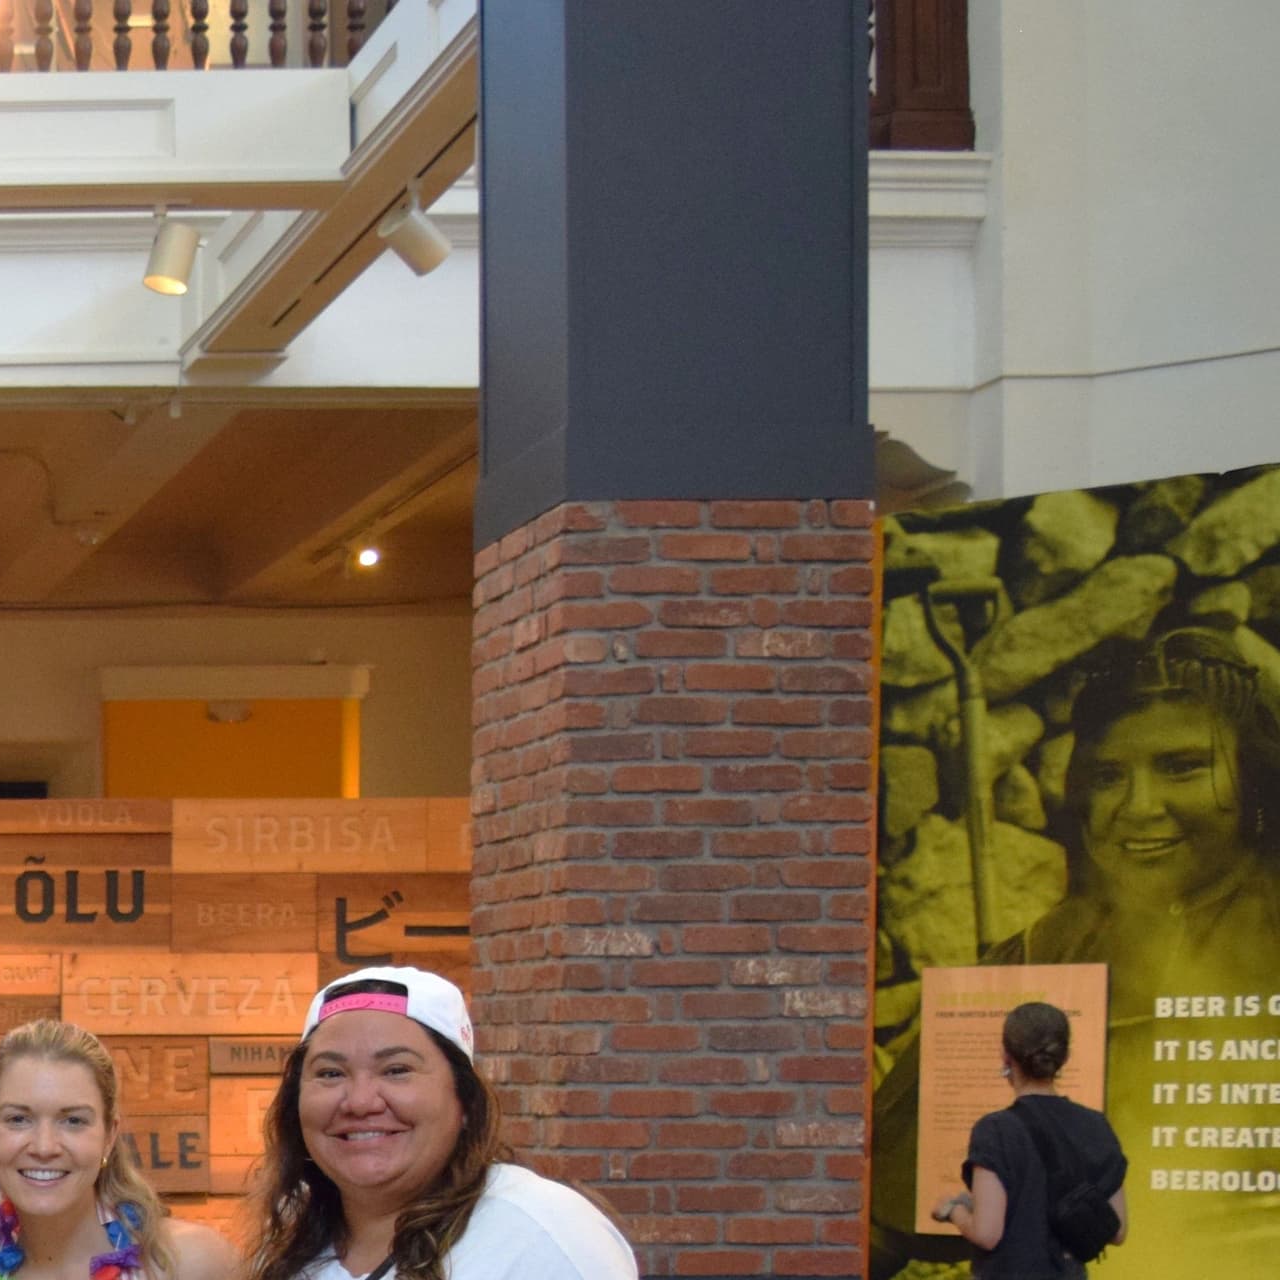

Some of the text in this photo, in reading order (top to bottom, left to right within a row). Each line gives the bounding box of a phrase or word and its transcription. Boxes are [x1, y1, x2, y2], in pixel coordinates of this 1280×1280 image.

[204, 815, 397, 852] SIRBISA
[15, 856, 145, 923] ÕLU
[81, 977, 296, 1016] CERVEZA
[1155, 997, 1225, 1018] BEER
[1234, 995, 1260, 1016] IS
[1154, 1040, 1180, 1061] IT
[1187, 1039, 1213, 1060] IS
[1153, 1084, 1179, 1104] IT
[1186, 1083, 1212, 1104] IS
[1152, 1127, 1177, 1147] IT
[1150, 1169, 1280, 1192] BEEROLO
